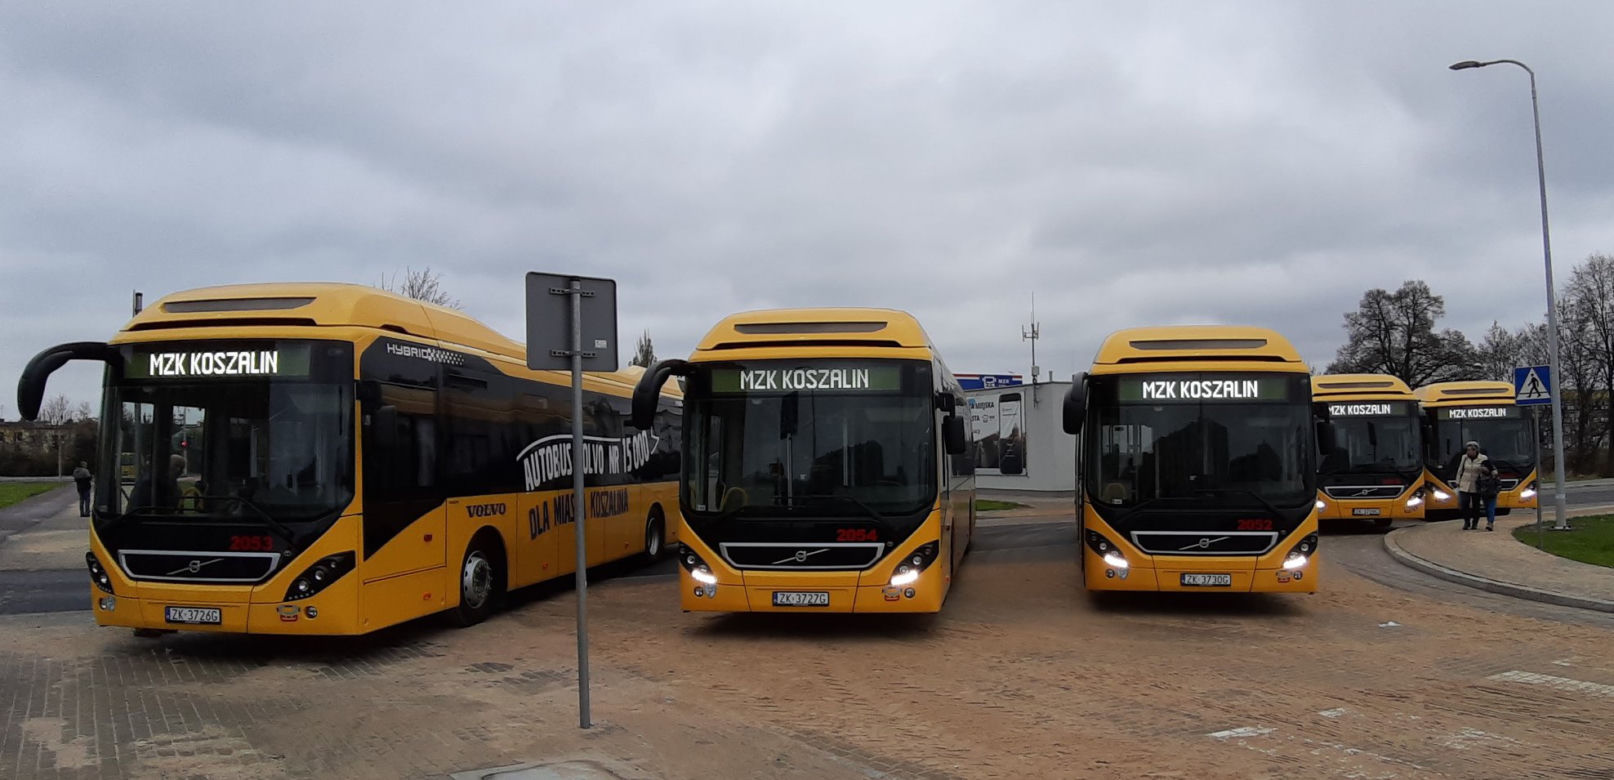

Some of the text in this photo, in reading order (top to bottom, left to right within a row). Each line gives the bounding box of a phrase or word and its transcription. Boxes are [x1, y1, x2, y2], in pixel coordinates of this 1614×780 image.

[386, 342, 430, 359] HYBRID
[150, 351, 278, 375] MZK KOSZALIN
[740, 369, 869, 389] MZK KOSZALIN
[1142, 380, 1258, 399] MZK KOSZALIN
[1328, 404, 1391, 416] MZK KOSZALIN
[1449, 408, 1506, 418] MZK KOSZALIN
[523, 442, 573, 491] AUTOBUS
[582, 443, 605, 475] OLVO
[608, 445, 620, 475] NR
[466, 503, 505, 517] VOLVO
[529, 500, 550, 540] DLA
[1237, 520, 1273, 530] 2052
[836, 529, 877, 541] 2054
[230, 536, 273, 550] 2053
